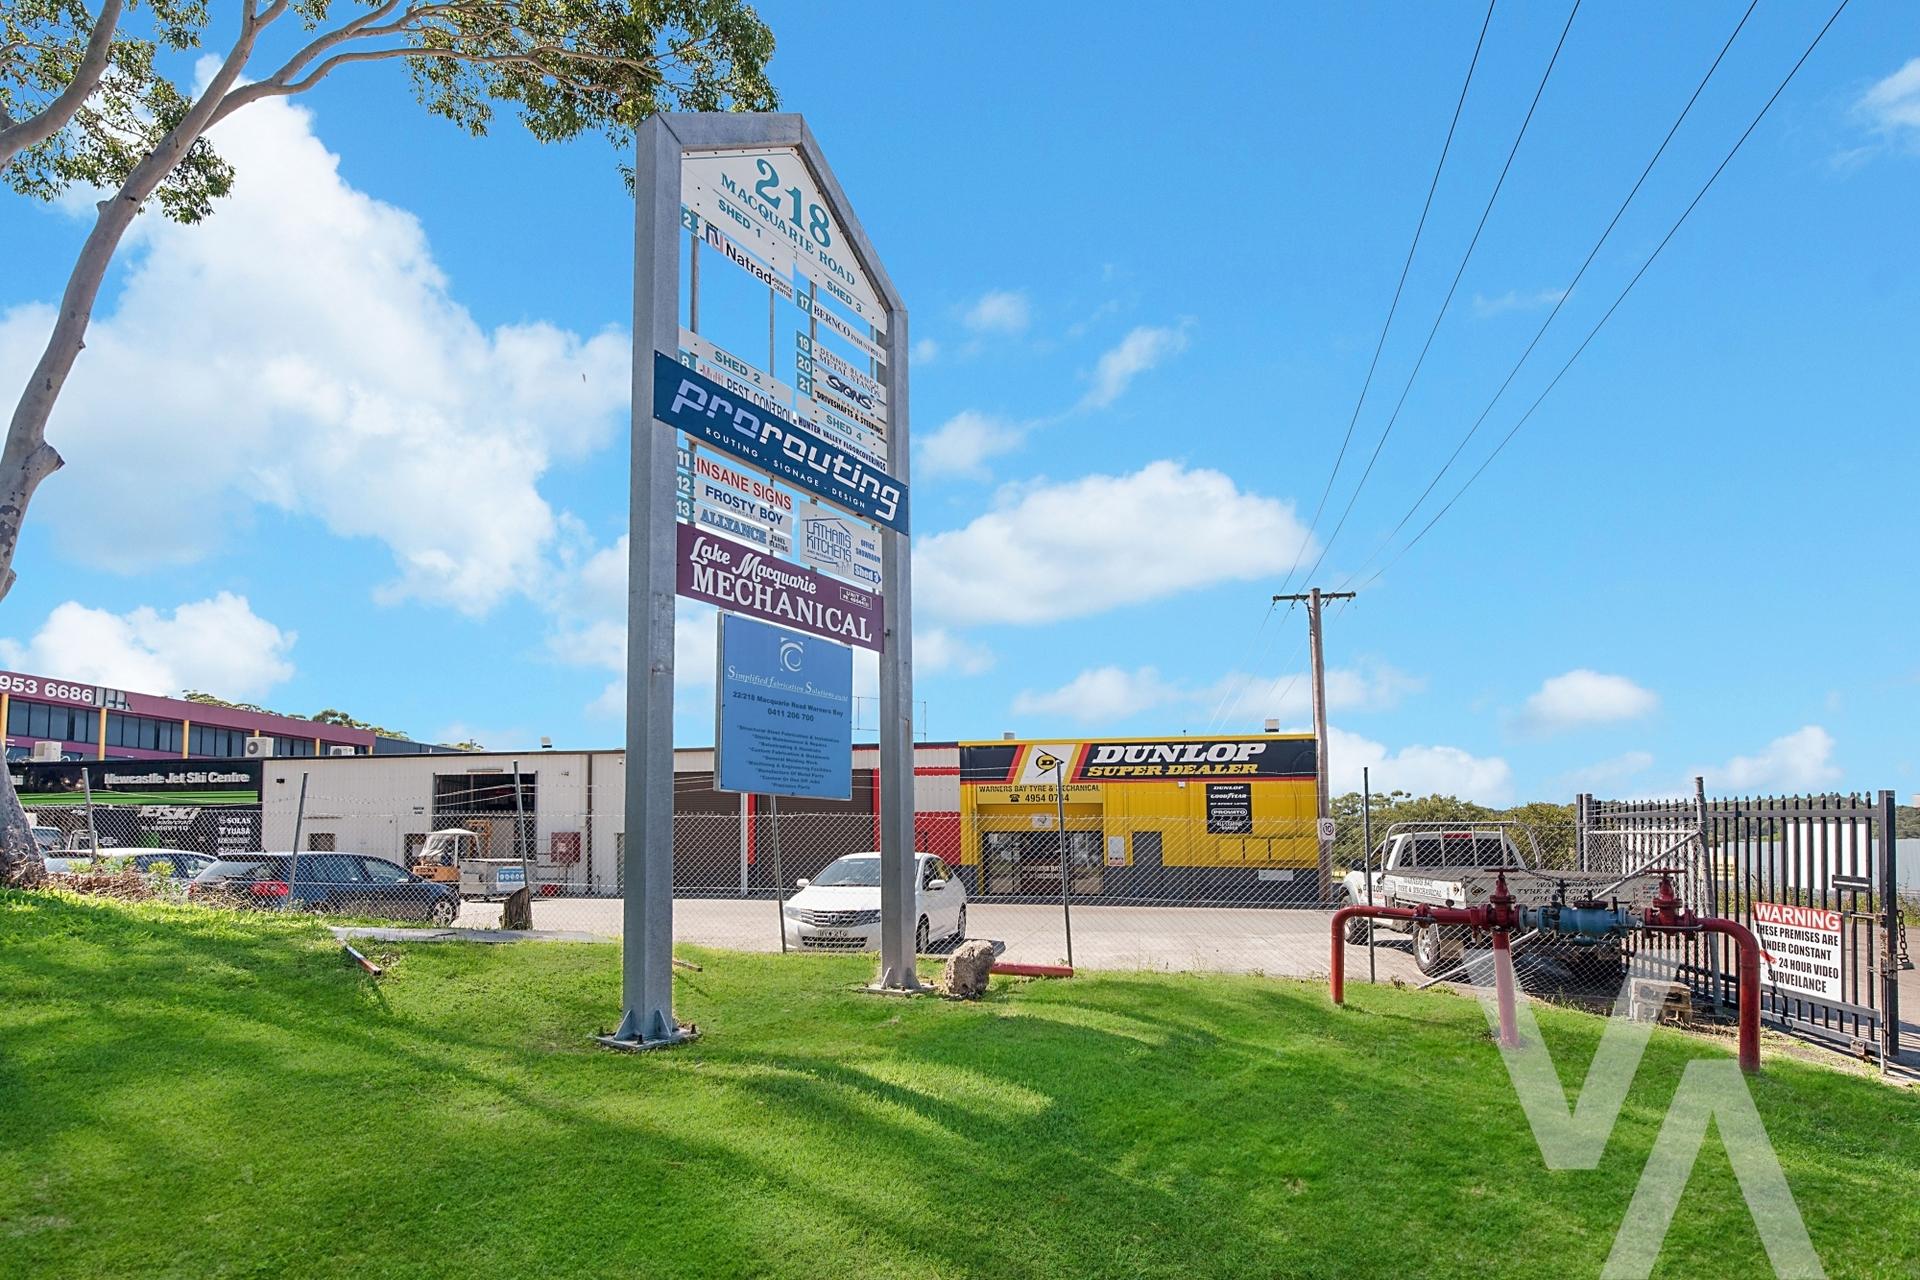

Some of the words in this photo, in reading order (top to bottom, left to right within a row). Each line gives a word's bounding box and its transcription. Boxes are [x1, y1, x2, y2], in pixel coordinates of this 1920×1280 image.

[755, 158, 832, 248] 218
[683, 212, 692, 230] 2
[718, 199, 750, 230] SHED
[756, 229, 761, 238] 1
[721, 172, 814, 254] MACQUARIE
[819, 254, 856, 286] ROAD
[726, 242, 772, 286] Natrad
[799, 295, 809, 310] 17
[826, 281, 852, 306] SHED
[856, 303, 862, 312] 3
[814, 304, 850, 337] BERNCO
[799, 335, 809, 351] 19
[714, 351, 748, 376] SHED
[753, 373, 761, 384] 2
[798, 356, 811, 373] 20
[818, 354, 847, 377] METAL
[798, 378, 810, 394] 21
[798, 416, 821, 434] HUNTER
[822, 429, 842, 445] VALLEY
[826, 414, 852, 435] SHED
[856, 432, 862, 441] 4
[677, 450, 690, 468] 11
[706, 427, 758, 458] ROUTING
[774, 459, 820, 488] SIGNAGE
[832, 488, 866, 509] DESIGN
[676, 476, 690, 493] 12
[696, 457, 749, 493] INSANE
[753, 482, 792, 510] SIGNS
[676, 500, 690, 518] 13
[705, 484, 756, 514] FROSTY
[760, 507, 783, 526] BOY
[806, 519, 852, 550] LATHAMS
[806, 534, 852, 562] KITCHENS
[690, 536, 730, 565] Lake
[732, 553, 817, 594] Macquarie
[691, 562, 872, 642] MECHANICAL
[0, 676, 38, 694] 953
[44, 682, 93, 702] 6686
[1092, 744, 1267, 764] DUNLOP
[104, 773, 164, 784] Newcastle
[165, 773, 187, 784] Jet
[188, 772, 206, 782] Ski
[208, 772, 250, 782] Centre
[1087, 764, 1165, 777] SUPER
[1167, 764, 1258, 776] DEALER
[1024, 794, 1046, 802] 4954
[1756, 904, 1840, 930] WARNING
[1756, 924, 1778, 937] THESE
[1780, 927, 1820, 944] PREMISES
[1822, 934, 1838, 946] ARE
[1762, 938, 1787, 953] UNDER
[1788, 942, 1832, 960] CONSTANT
[1768, 968, 1827, 994] SURVEILANCE
[1778, 957, 1788, 969] 24
[1790, 960, 1812, 974] HOUR
[1814, 964, 1839, 980] VIDEO
